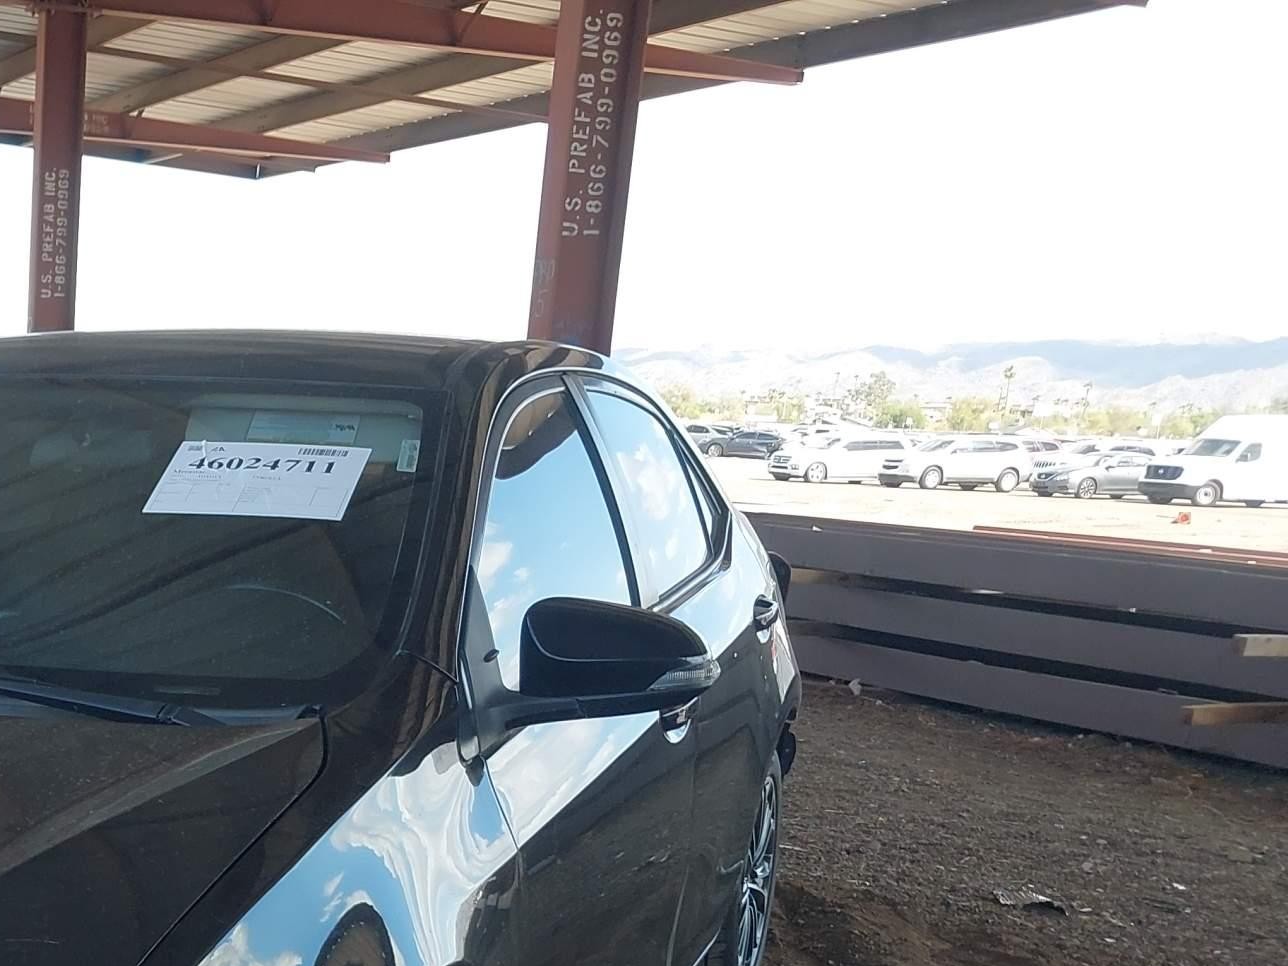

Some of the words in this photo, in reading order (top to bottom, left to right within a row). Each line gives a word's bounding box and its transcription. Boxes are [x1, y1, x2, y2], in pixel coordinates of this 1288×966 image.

[580, 8, 604, 58] INC.
[568, 72, 596, 174] PREFAB
[582, 11, 624, 237] 1-866-799-0969
[43, 167, 57, 196] INC.
[41, 203, 55, 263] PREFAB
[561, 189, 583, 238] U.S.
[40, 269, 54, 299] U.S.
[188, 456, 337, 475] 46024711
